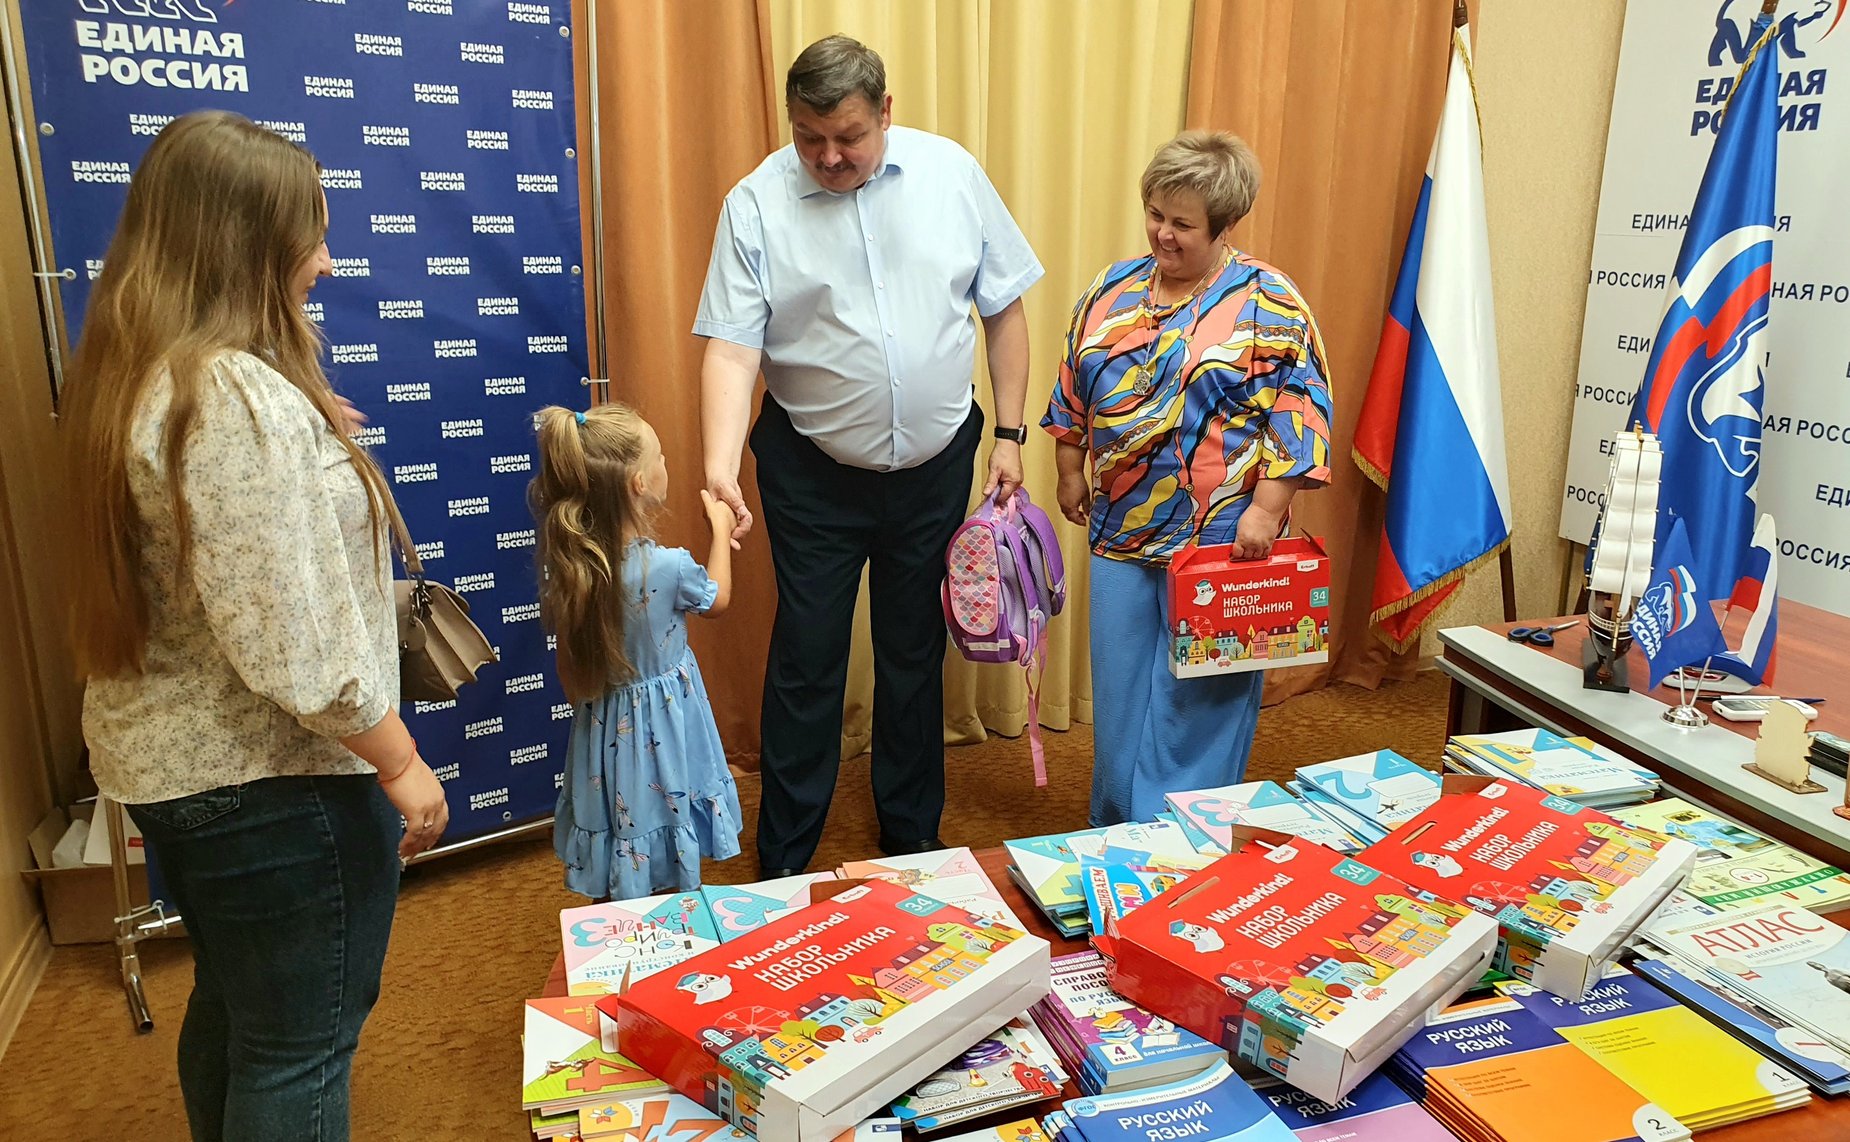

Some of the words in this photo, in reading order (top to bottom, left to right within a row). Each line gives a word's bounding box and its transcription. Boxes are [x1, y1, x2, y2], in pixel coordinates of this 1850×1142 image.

[408, 2, 452, 15] РОССИЯ
[508, 2, 549, 15] ЕДИНАЯ
[509, 12, 550, 24] РОССИЯ
[75, 20, 245, 58] ЕДИНАЯ
[355, 33, 402, 46] ЕДИНАЯ
[356, 44, 402, 56] РОССИЯ
[460, 42, 503, 54] ЕДИНАЯ
[461, 52, 504, 64] РОССИЯ
[81, 54, 249, 92] РОССИЯ
[304, 76, 353, 88] ЕДИНАЯ
[1696, 69, 1827, 105] ЕДАЯ
[306, 86, 354, 98] РОССИЯ
[414, 83, 458, 94] ЕДИНАЯ
[415, 93, 459, 104] РОССИЯ
[512, 90, 552, 100] ЕДИНАЯ
[513, 99, 553, 109] РОССИЯ
[129, 114, 175, 126] ЕДИНА
[261, 121, 305, 132] ДИНАЯ
[363, 126, 409, 136] ЕДИНАЯ
[364, 135, 410, 146] РОССИЯ
[467, 130, 508, 140] ЕДИНАЯ
[468, 139, 508, 150] РОССИЯ
[72, 161, 129, 172] ЕДИНАЯ
[73, 172, 131, 183] РОССИЯ
[320, 168, 361, 178] ДИНАЯ
[421, 172, 464, 181] ЕДИНАЯ
[517, 174, 557, 183] ЕДИНАЯ
[421, 181, 465, 191] РОССИЯ
[518, 183, 558, 192] РОССИЯ
[371, 215, 415, 224] ЕДИНАЯ
[472, 216, 514, 224] ЕДИНАЯ
[1632, 214, 1690, 232] ЕДИНА
[372, 224, 416, 233] РОССИЯ
[473, 225, 514, 233] РОССИЯ
[331, 258, 369, 268] ДИНАЯ
[427, 257, 469, 266] ЕДИНАЯ
[523, 257, 561, 265] ЕДИНАЯ
[331, 267, 370, 277] ОССИЯ
[428, 266, 470, 275] РОССИЯ
[524, 265, 562, 274] РОССИЯ
[1597, 271, 1666, 290] РОССИЯ
[1771, 281, 1815, 301] НАЯ
[379, 300, 423, 309] ЕДИНАЯ
[478, 298, 518, 307] ЕДИНАЯ
[380, 309, 423, 319] РОССИЯ
[478, 306, 518, 315] РОССИЯ
[434, 339, 476, 349] ЕДИНАЯ
[528, 336, 567, 344] ЕДИНАЯ
[1617, 335, 1651, 354] ЕДИ
[332, 344, 377, 354] ЕДИНАЯ
[435, 348, 477, 358] РОССИЯ
[529, 344, 567, 353] РОССИЯ
[333, 353, 378, 363] РОССИЯ
[387, 383, 430, 393] ЕДИНАЯ
[485, 377, 525, 387] ЕДИНАЯ
[486, 386, 525, 395] РОССИЯ
[1583, 385, 1638, 406] РОССИ
[388, 392, 431, 402] РОССИЯ
[441, 419, 482, 430] ЕДИНАЯ
[442, 428, 483, 438] РОССИЯ
[1796, 419, 1850, 445] РОСС
[491, 454, 530, 465] ЕДИНАЯ
[394, 463, 437, 474] ЕДИНАЯ
[492, 463, 530, 473] РОССИЯ
[395, 472, 437, 483] РОССИЯ
[448, 497, 488, 508] ЕДИНАЯ
[449, 505, 489, 517] РОССИЯ
[497, 530, 535, 541] ЕДИНАЯ
[414, 541, 444, 552] ИНАЯ
[497, 537, 535, 549] РОССИЯ
[418, 549, 445, 561] ССИЯ
[1777, 537, 1850, 572] ОССИЯ
[454, 572, 494, 585] ЕДИНАЯ
[455, 580, 495, 594] РОССИЯ
[1221, 577, 1290, 593] Wunderkind!
[1223, 594, 1260, 608] НАБОР
[1313, 590, 1326, 601] 34
[502, 603, 540, 615] ЕДИНАЯ
[1223, 601, 1293, 619] ШКОЛЬНИКА
[503, 611, 540, 623] РОССИЯ
[1636, 604, 1662, 652] ДИНАЯ
[506, 673, 543, 686] ЕДИНАЯ
[506, 681, 543, 694] РОССИЯ
[416, 699, 457, 715] РОССИЯ
[552, 709, 574, 721] РОСС
[466, 717, 502, 731] ЕДИНАЯ
[466, 725, 503, 739] РОССИЯ
[510, 744, 547, 757] ЕДИНАЯ
[511, 751, 547, 765] РОССИЯ
[433, 763, 459, 774] ИНАЯ
[1313, 770, 1372, 800] 2
[470, 788, 508, 802] ЕДИНАЯ
[471, 796, 508, 810] РОССИЯ
[1547, 799, 1570, 811] 34
[1440, 806, 1509, 852] Wunderkind!
[1469, 833, 1513, 864] НАБОР
[1489, 821, 1560, 871] ШКОЛЬНИКА
[1340, 863, 1365, 880] 34
[905, 896, 932, 912] 34
[1206, 872, 1294, 924] Wunderkind!
[1236, 904, 1289, 940] НАБОР
[1256, 891, 1347, 949] ШКОЛЬНИКА
[1690, 910, 1825, 957] АТЛАС
[727, 911, 851, 971] Wunderkind!
[753, 944, 823, 983] НАБОР
[770, 925, 896, 992] ШКОЛЬНИКА
[1053, 971, 1107, 986] СПРАВО
[1071, 980, 1109, 992] ПОСО
[1550, 983, 1629, 1007] РСКИЙ
[1579, 998, 1633, 1016] ЯЗЫК
[1426, 1018, 1511, 1045] РУССКИЙ
[1115, 1045, 1126, 1056] 4
[1455, 1035, 1513, 1054] ЯЗЫК
[1772, 1071, 1791, 1083] 1
[1268, 1089, 1317, 1107] РУСС
[1297, 1097, 1357, 1118] ЯЗЫК
[1117, 1100, 1213, 1130] РУССКИЙ
[1647, 1118, 1667, 1131] 2
[1146, 1120, 1210, 1142] ЯЗЫК
